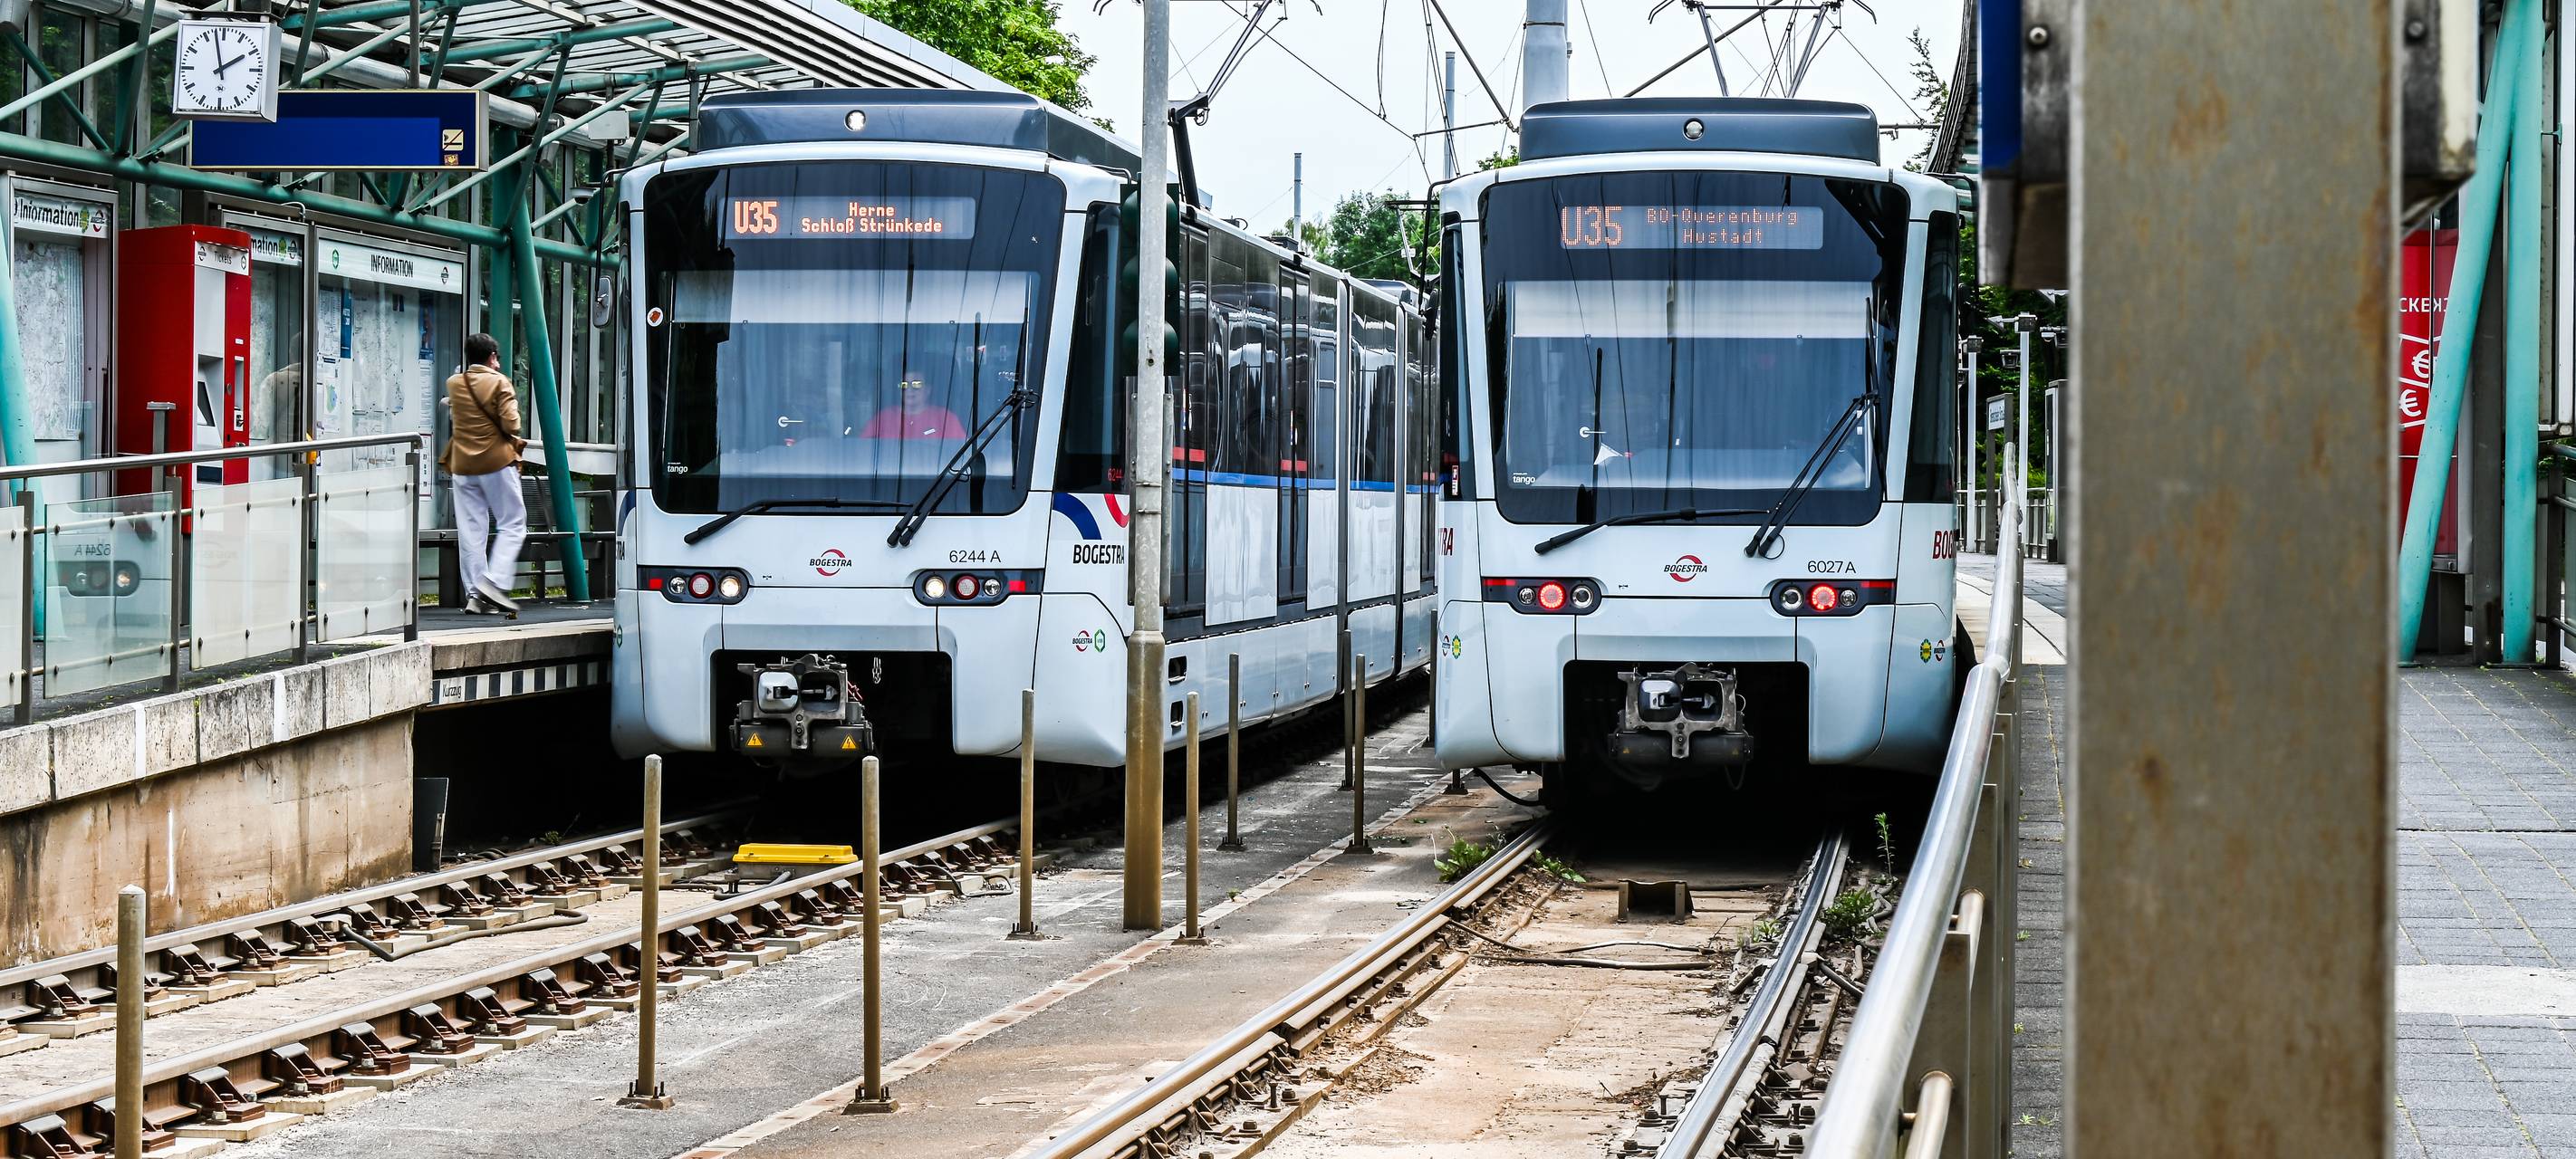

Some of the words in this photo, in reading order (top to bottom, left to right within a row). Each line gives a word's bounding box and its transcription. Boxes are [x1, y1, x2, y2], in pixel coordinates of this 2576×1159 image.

[20, 198, 79, 227] Information
[849, 202, 895, 217] Herne
[1647, 207, 1798, 225] BO-Querenburg
[734, 201, 777, 234] U35
[802, 217, 854, 234] Schloß
[860, 216, 942, 233] Strünkede
[1562, 206, 1622, 245] U35
[1683, 228, 1763, 244] Hustadt
[215, 251, 232, 265] Tickets
[370, 254, 414, 278] INFORMATION
[668, 465, 688, 474] tango
[1513, 475, 1536, 484] tango
[949, 550, 986, 563] 6244
[990, 550, 1002, 563] A
[1072, 544, 1125, 564] BOGESTRA
[809, 558, 852, 568] BOGESTRA
[1663, 564, 1708, 573] BOGESTRA
[1807, 560, 1843, 574] 6027
[1844, 560, 1857, 574] A
